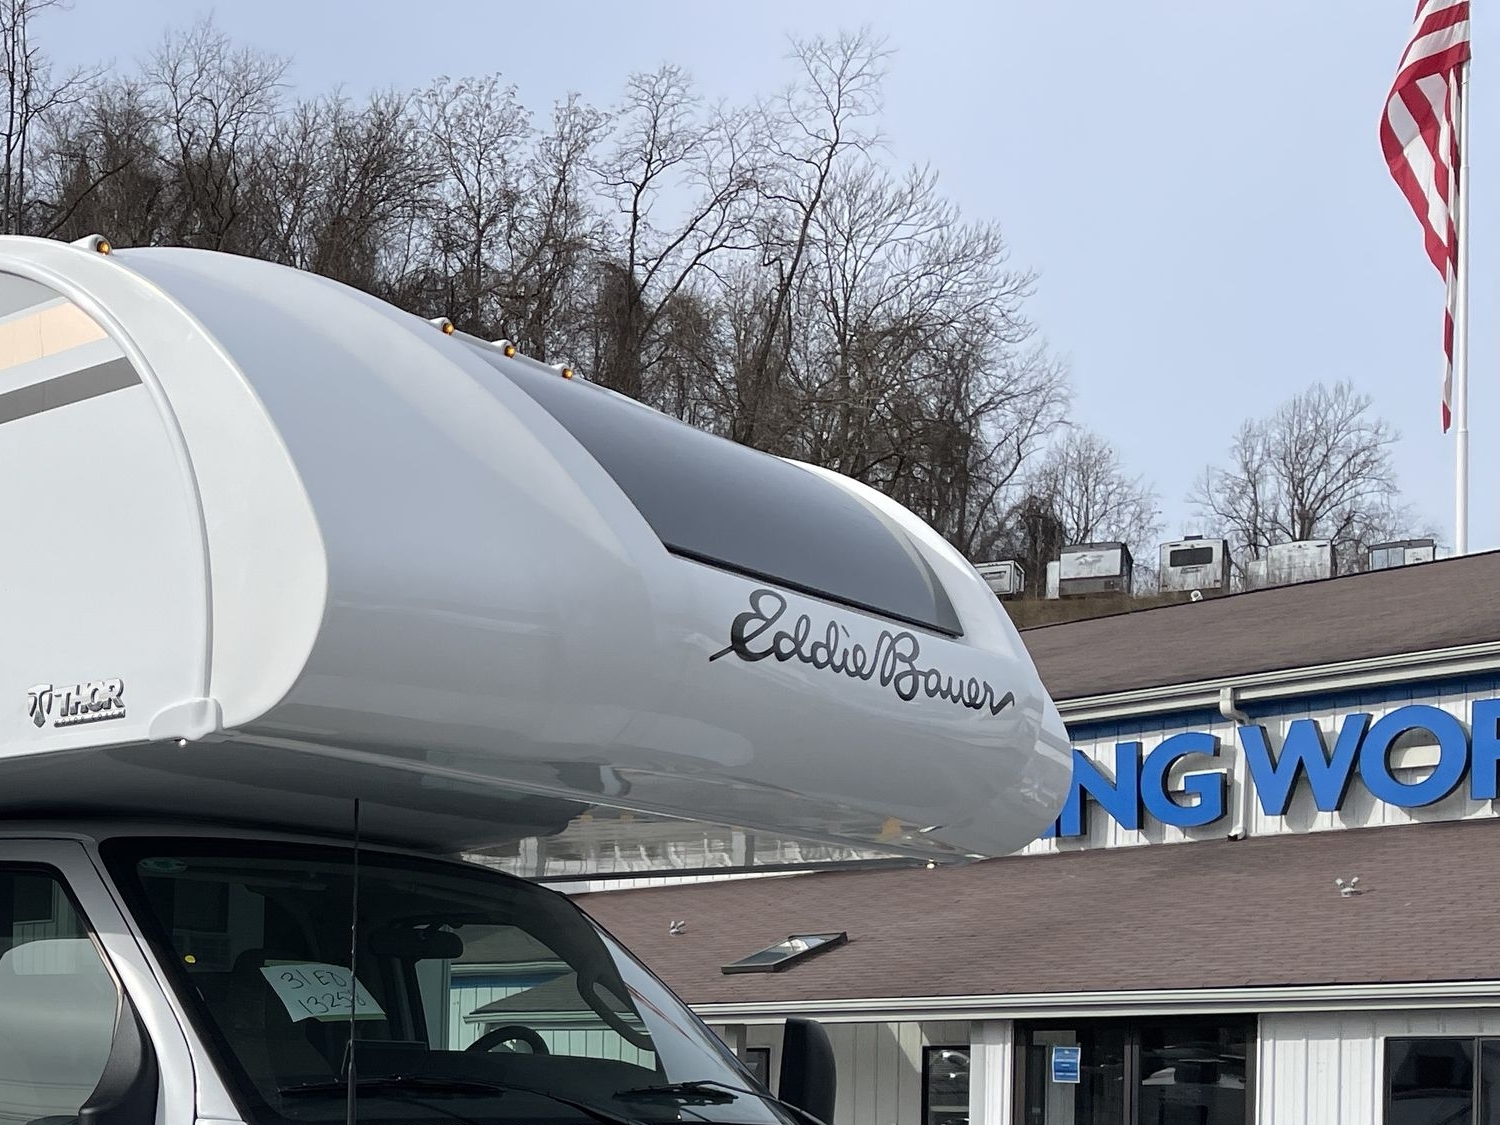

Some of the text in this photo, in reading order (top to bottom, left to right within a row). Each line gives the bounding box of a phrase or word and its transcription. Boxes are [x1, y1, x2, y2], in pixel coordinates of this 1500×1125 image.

[54, 679, 125, 717] THOR
[709, 588, 1015, 716] Eddie Bauer
[1041, 731, 1228, 838] NG
